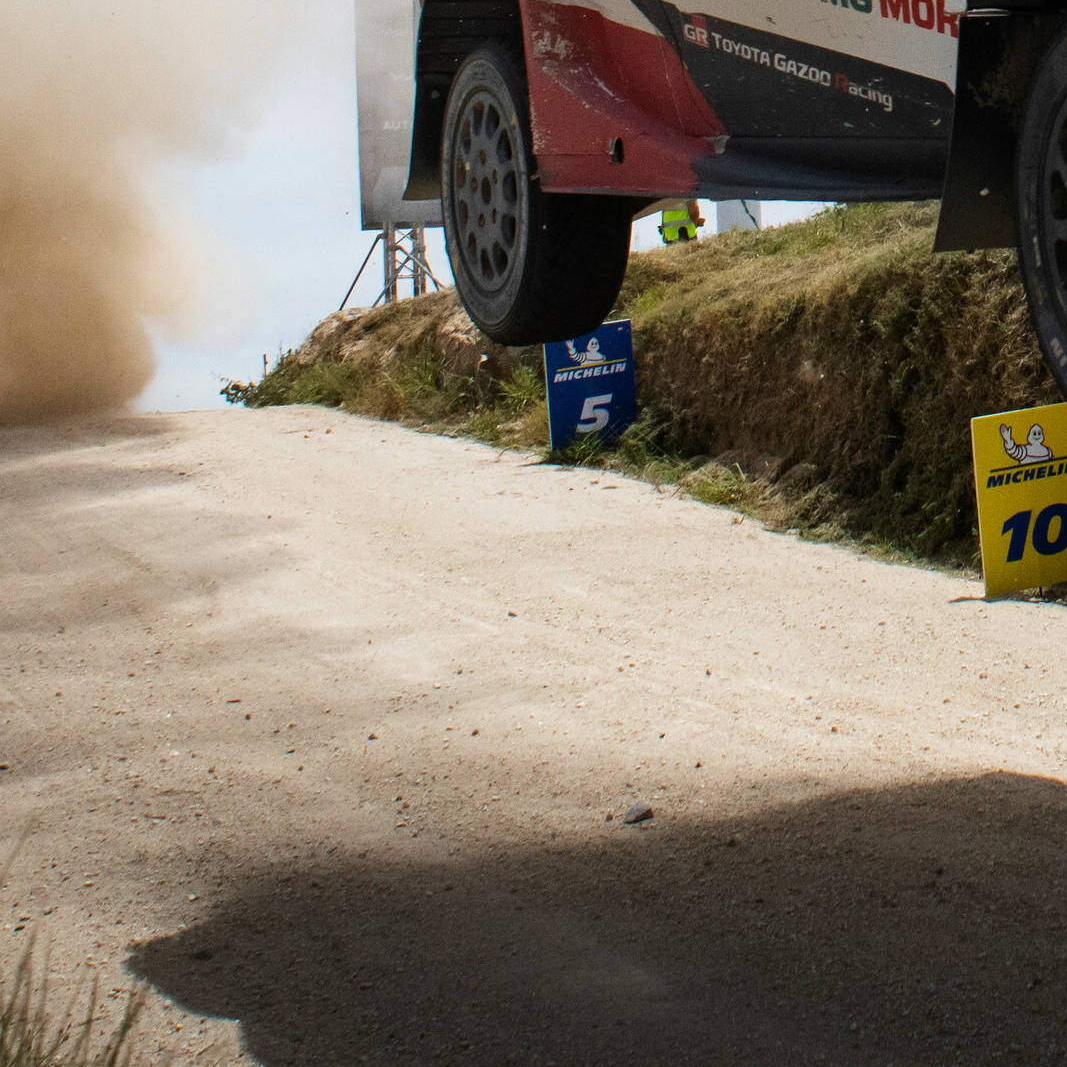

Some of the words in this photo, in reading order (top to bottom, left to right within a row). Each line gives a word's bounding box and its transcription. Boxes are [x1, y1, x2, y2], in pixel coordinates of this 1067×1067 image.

[683, 24, 709, 46] GR
[711, 32, 771, 67] TOYOTA
[773, 53, 831, 87] GAZOO
[835, 72, 893, 112] Racing
[553, 361, 627, 383] MICHELIN
[576, 393, 613, 433] 5
